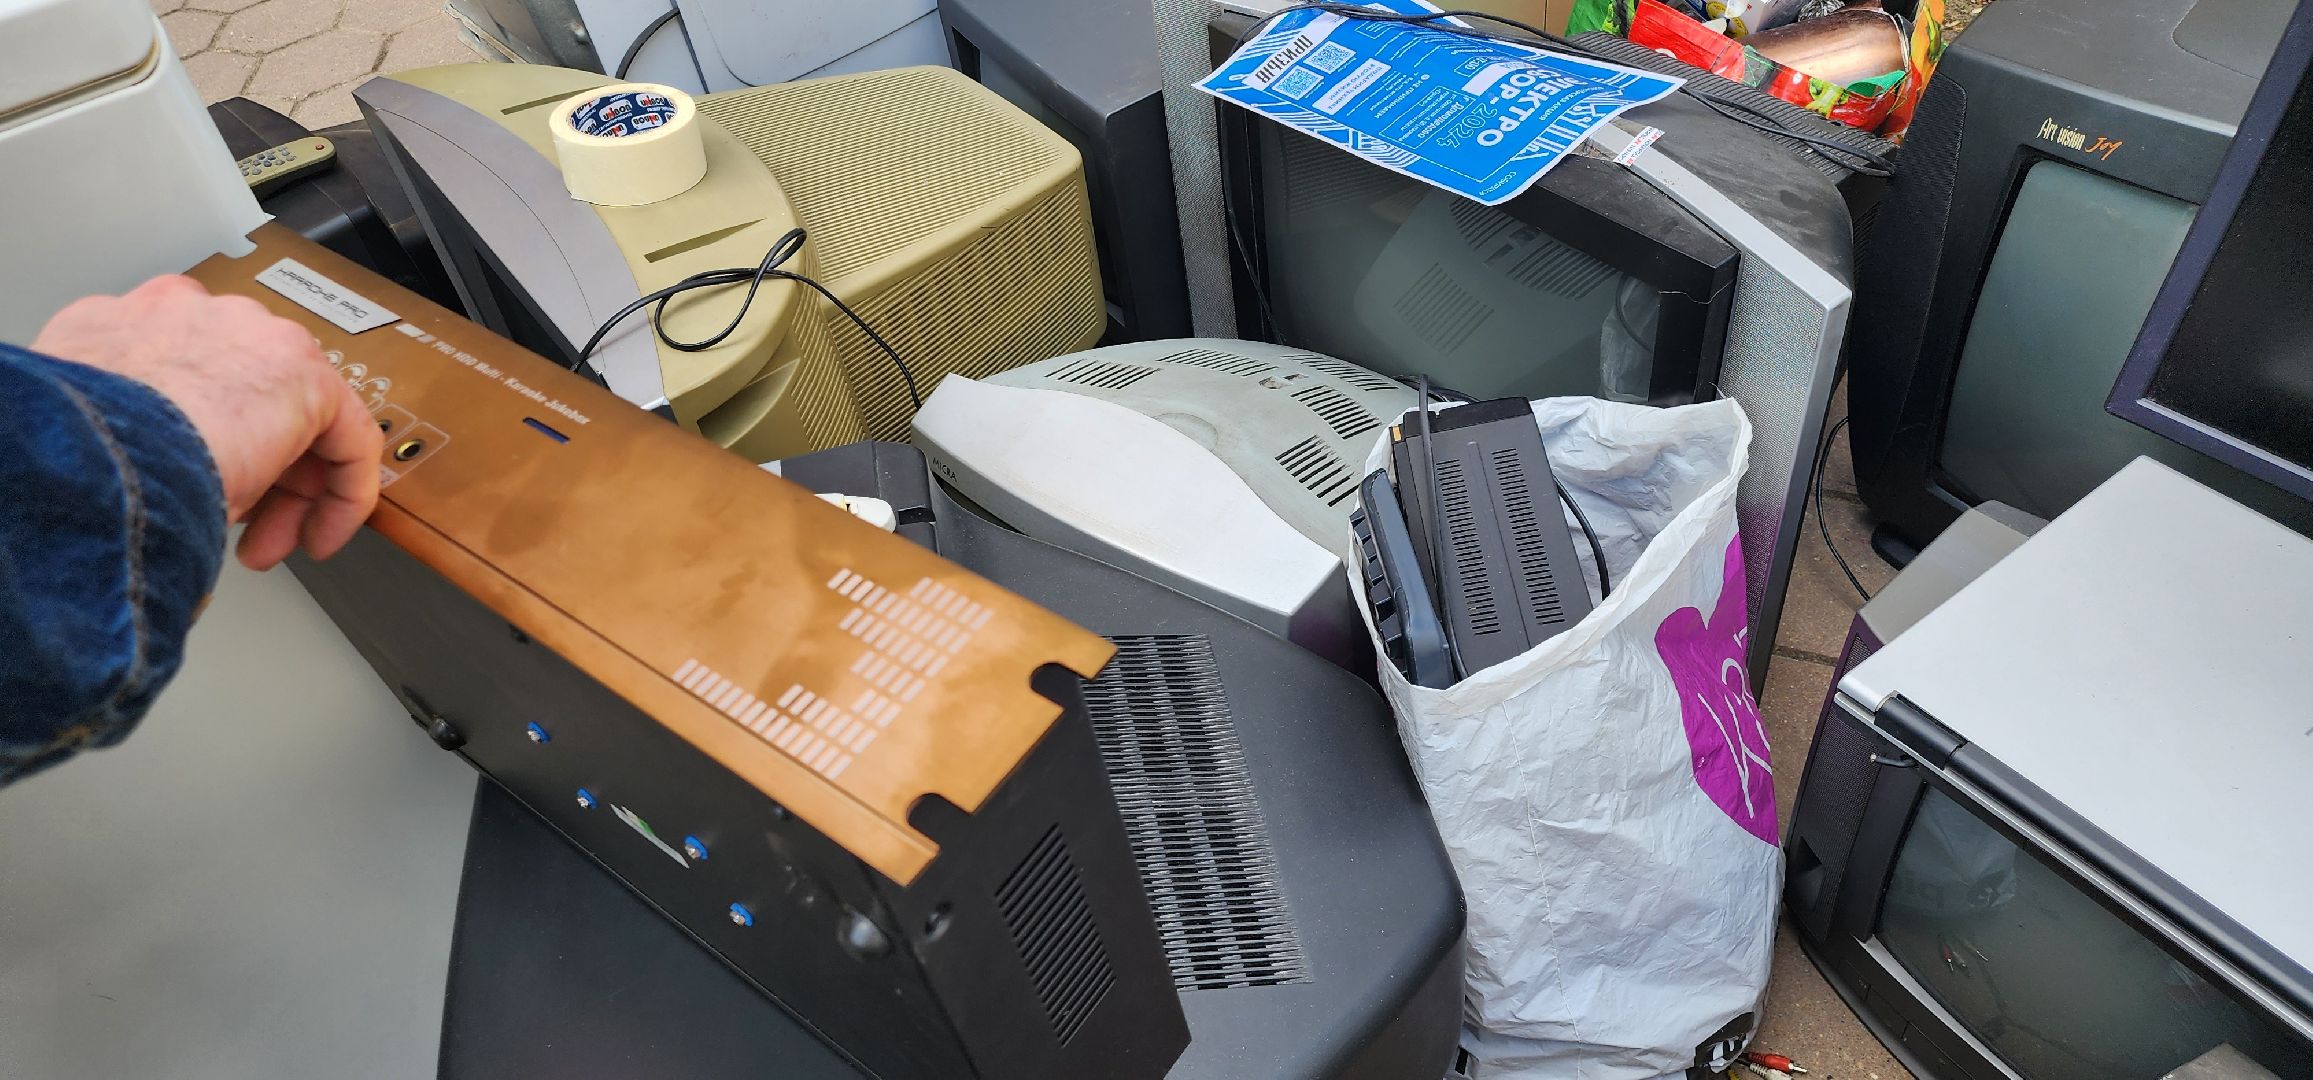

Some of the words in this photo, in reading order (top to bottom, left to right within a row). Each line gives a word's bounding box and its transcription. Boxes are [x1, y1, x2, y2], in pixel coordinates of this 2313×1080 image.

[1252, 34, 1315, 83] ПРИЗЫВ
[1351, 66, 1383, 90] ПОДАРИМ
[1325, 88, 1355, 110] ТЕХНИКЕ
[1373, 86, 1416, 119] ПРИНИМАЕМ
[1476, 77, 1589, 146] ЭЛЕКТРО
[1536, 100, 1560, 121] АКЦИЯ
[1435, 102, 1499, 147] 2024
[2035, 117, 2058, 141] Art
[2057, 125, 2086, 151] vision
[339, 300, 368, 319] PRO
[431, 341, 456, 355] PRO
[503, 377, 548, 403] Karaoke
[543, 400, 591, 425] Jukebox
[933, 457, 957, 483] MICRA
